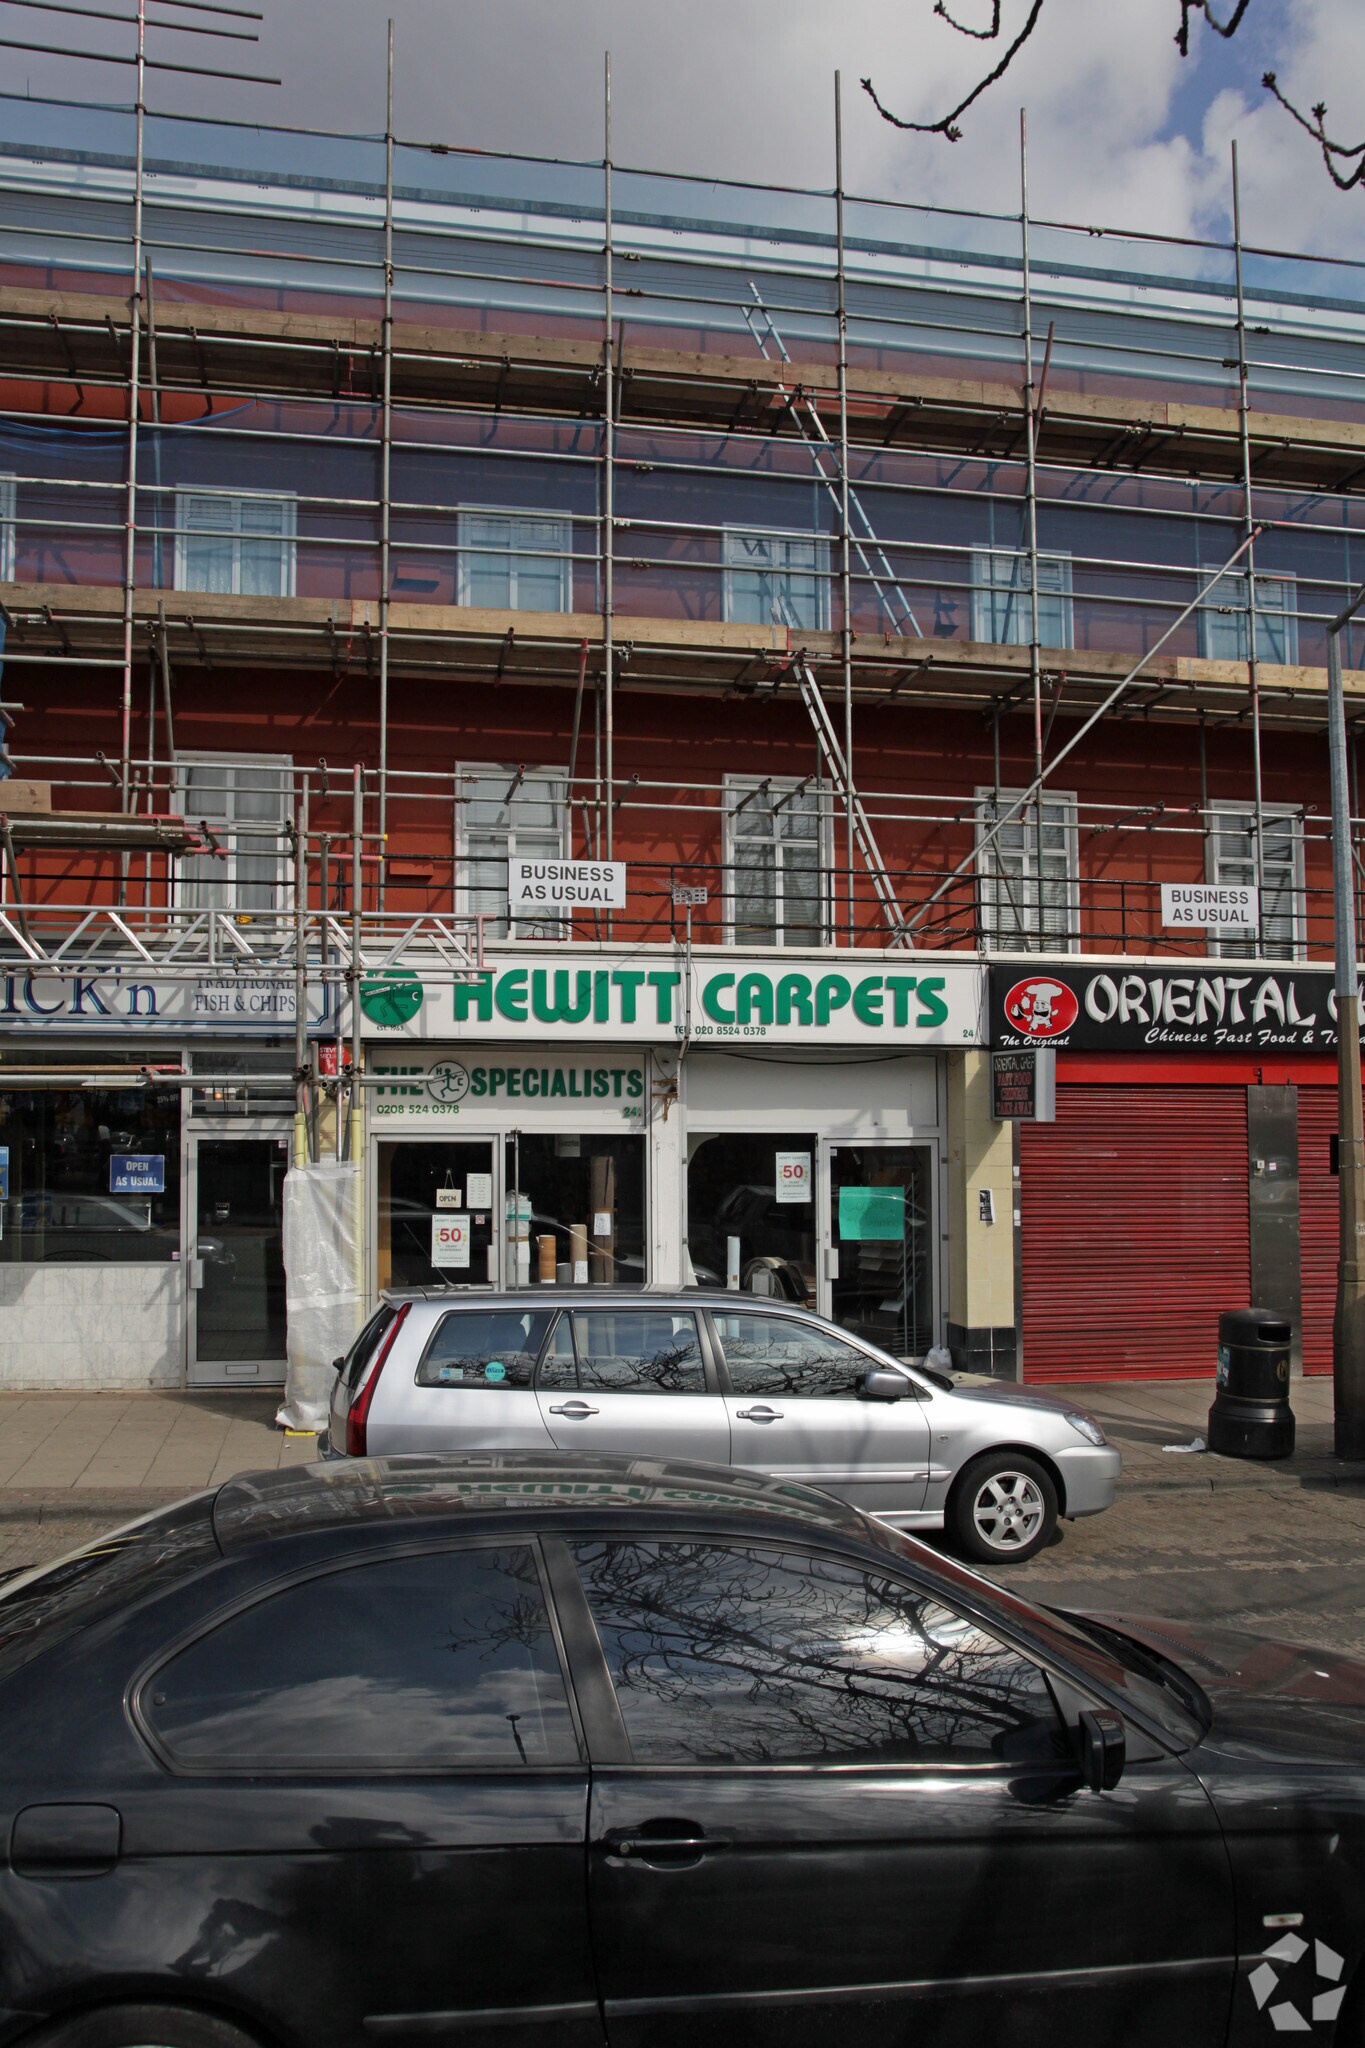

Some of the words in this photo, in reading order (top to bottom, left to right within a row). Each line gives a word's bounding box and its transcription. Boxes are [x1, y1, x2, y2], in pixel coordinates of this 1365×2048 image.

[521, 865, 614, 882] BUSINESS
[521, 885, 547, 900] AS
[551, 886, 615, 902] USUAL
[1171, 890, 1249, 905] BUSINESS
[1172, 908, 1194, 922] AS
[1198, 909, 1249, 923] USUAL
[196, 973, 294, 990] TRADITIONAL
[195, 994, 229, 1011] FISH
[234, 994, 246, 1012] &
[250, 994, 296, 1012] CHIPS
[453, 967, 681, 1024] HEWITT
[702, 972, 949, 1028] CARPETS
[1084, 974, 1317, 1027] ORIENTAL
[695, 1025, 714, 1035] 020
[716, 1026, 740, 1036] 8524
[743, 1026, 767, 1036] 0378
[962, 1028, 974, 1038] 24
[1145, 1027, 1208, 1044] Chinese
[1213, 1028, 1253, 1045] Fast
[1257, 1029, 1298, 1046] Food
[1302, 1029, 1315, 1044] &
[265, 1038, 281, 1048] 22
[1000, 1034, 1020, 1046] The
[1023, 1035, 1070, 1048] Original
[373, 1066, 424, 1096] THE
[471, 1066, 644, 1098] SPECIALISTS
[997, 1072, 1013, 1086] FAST
[1013, 1071, 1032, 1086] FOOD
[376, 1104, 405, 1114] 0208
[408, 1104, 430, 1114] 524
[432, 1104, 460, 1114] 0378
[996, 1101, 1013, 1115] TAKE
[1013, 1101, 1033, 1115] AWAY
[126, 1160, 149, 1172] OPEN
[783, 1164, 804, 1179] 50
[115, 1175, 128, 1186] AS
[130, 1176, 160, 1187] USUAL
[439, 1228, 462, 1243] 50
